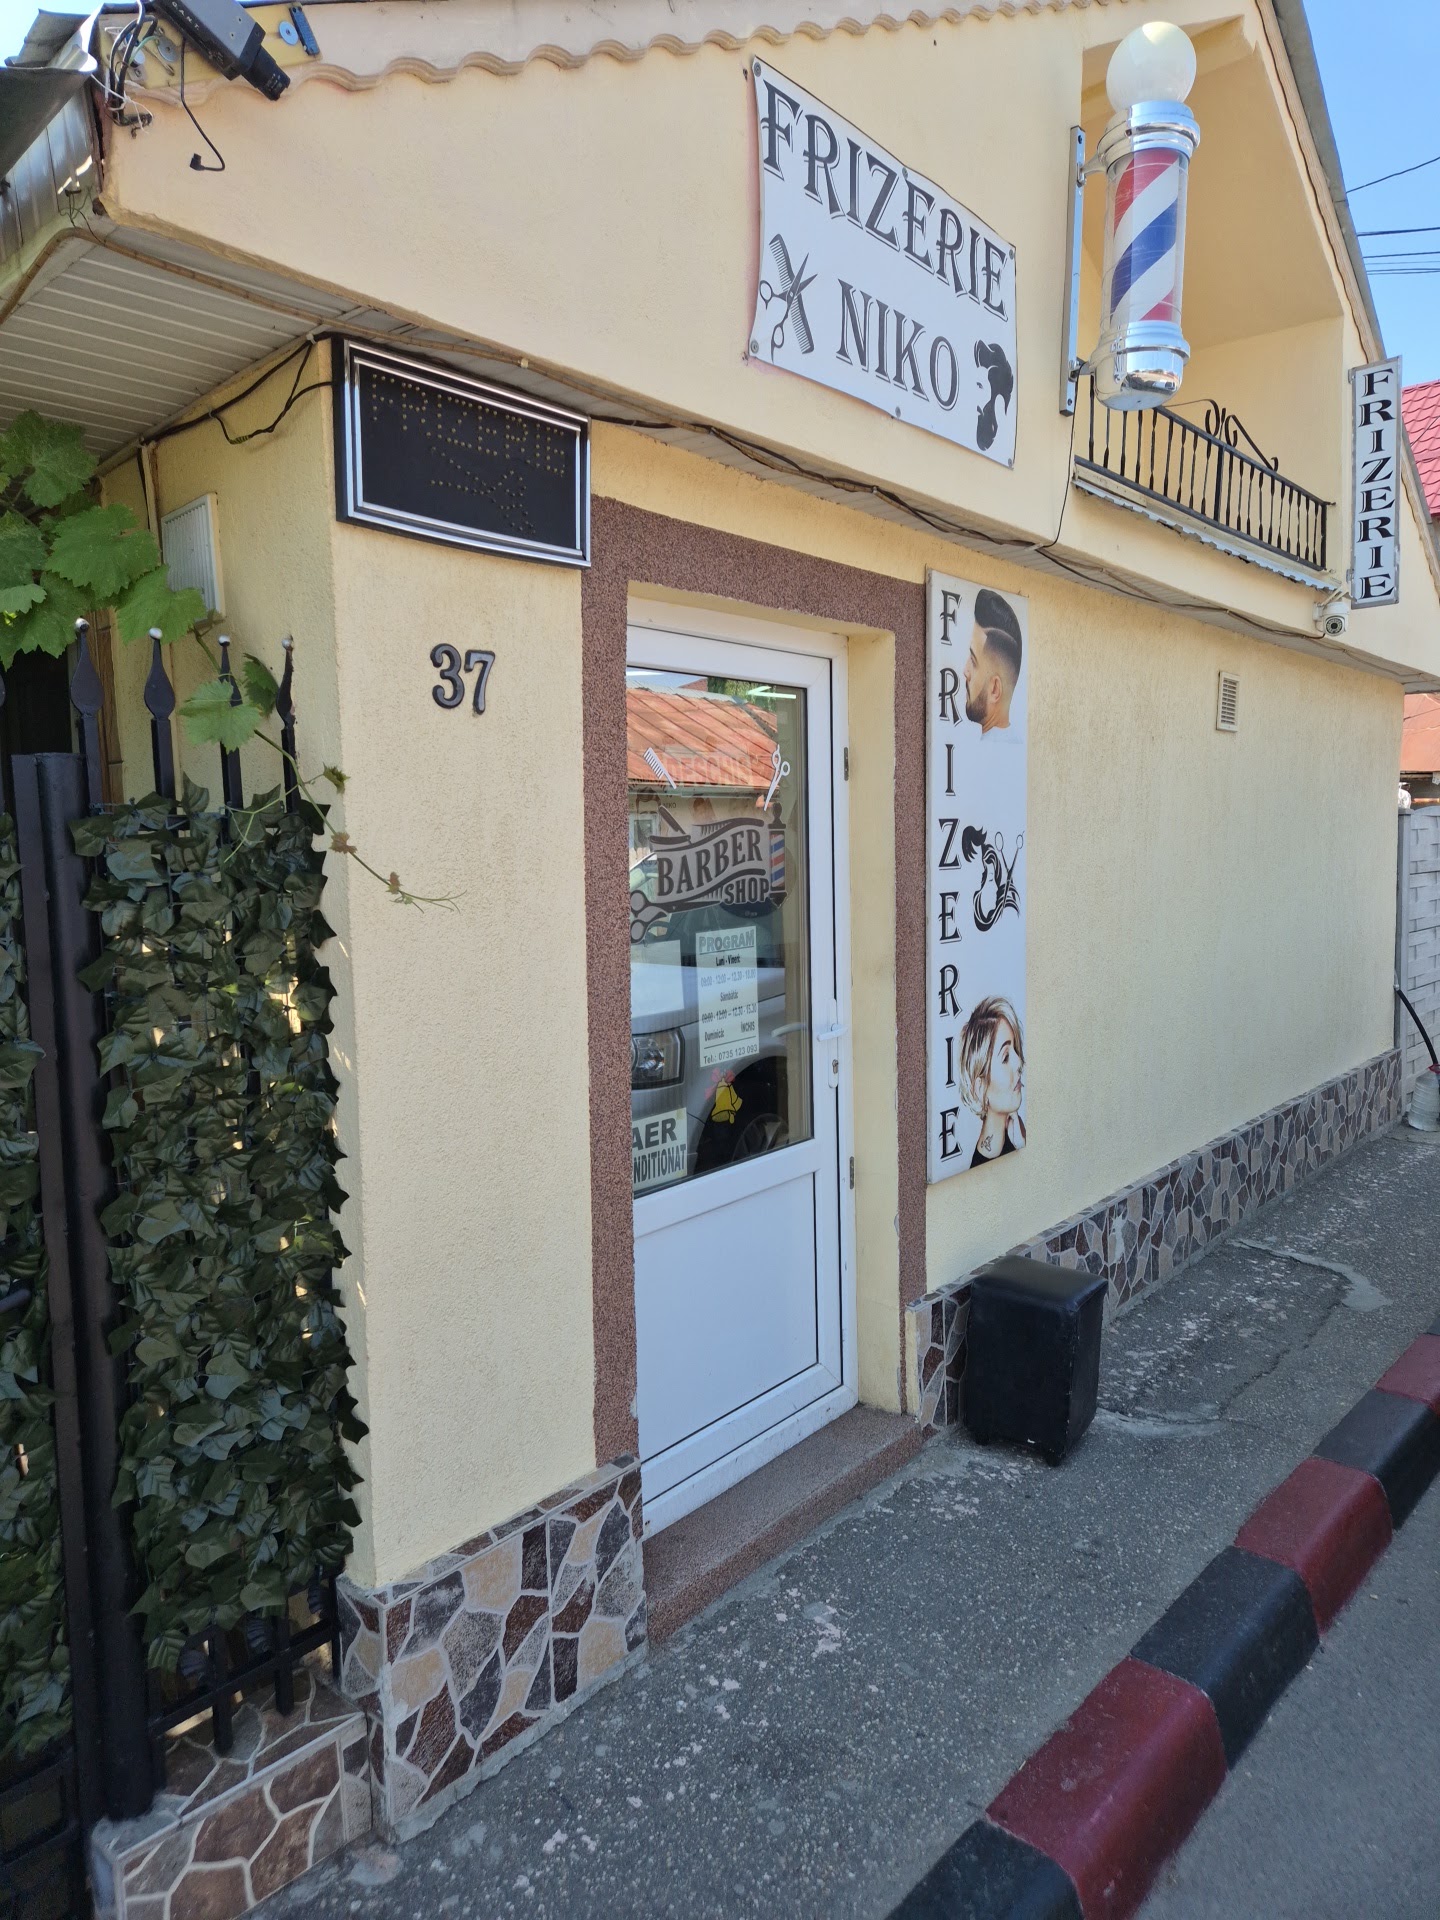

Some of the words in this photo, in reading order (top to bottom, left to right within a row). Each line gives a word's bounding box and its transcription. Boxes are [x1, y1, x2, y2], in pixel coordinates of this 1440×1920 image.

[760, 80, 1008, 322] FRIZERIE
[835, 279, 959, 411] NIKO
[371, 373, 566, 477] FRIZERIE
[1357, 368, 1396, 599] FRIZERIE
[430, 643, 496, 716] 37
[657, 829, 764, 897] BARBER
[724, 876, 769, 905] SHOP
[938, 589, 963, 1160] FRIZERIE
[699, 929, 754, 952] PROGRAM
[718, 1049, 734, 1061] 0735
[734, 1046, 746, 1057] 123
[632, 1117, 678, 1151] AER
[633, 1143, 687, 1184] NDITIONAT
